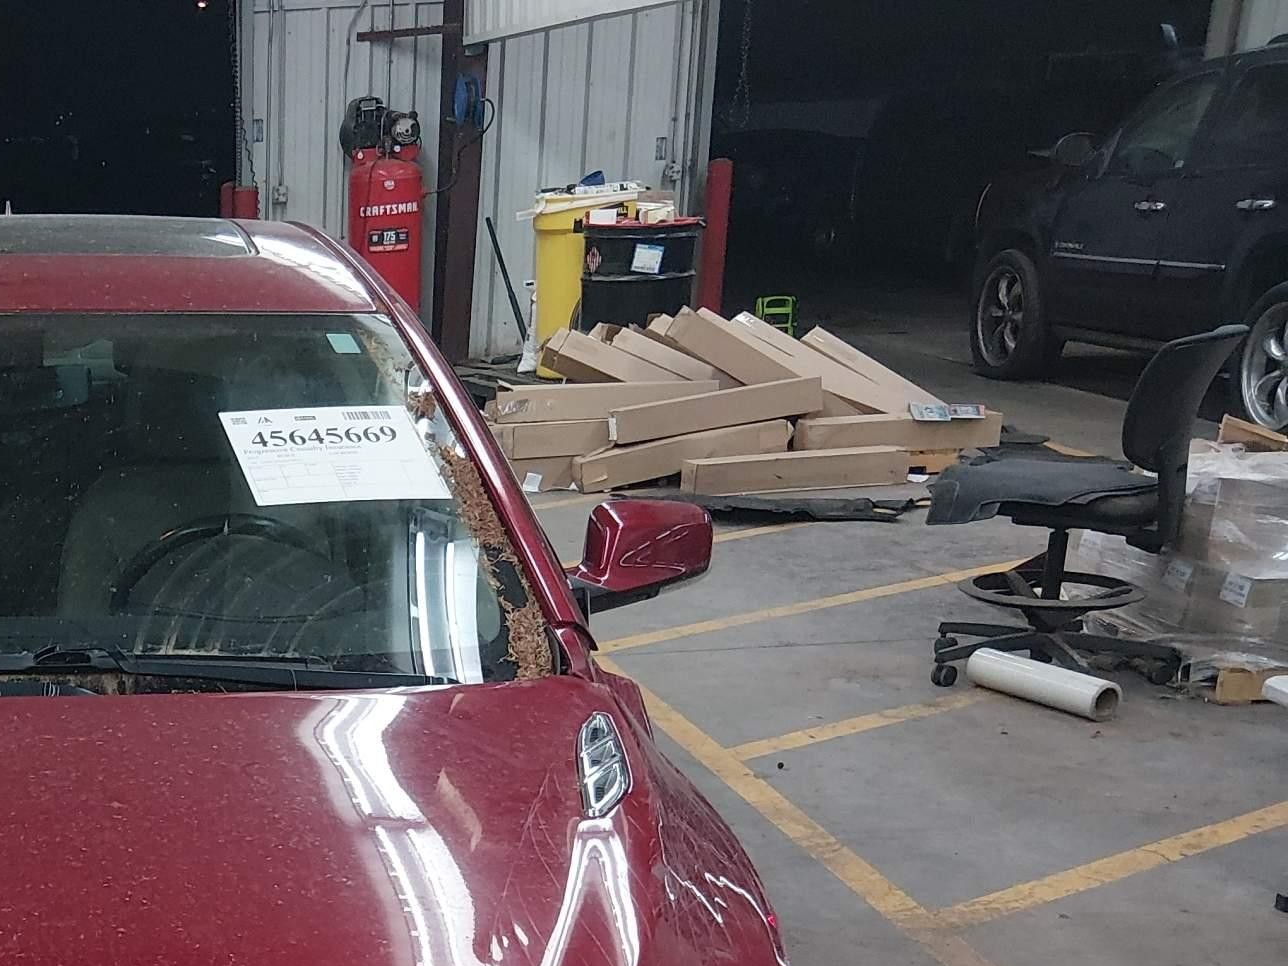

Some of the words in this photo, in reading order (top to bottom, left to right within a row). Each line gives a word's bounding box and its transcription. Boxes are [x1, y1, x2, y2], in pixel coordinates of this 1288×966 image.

[360, 201, 419, 217] CRAFTSMAN
[383, 231, 396, 241] 175
[251, 425, 397, 447] 45645669
